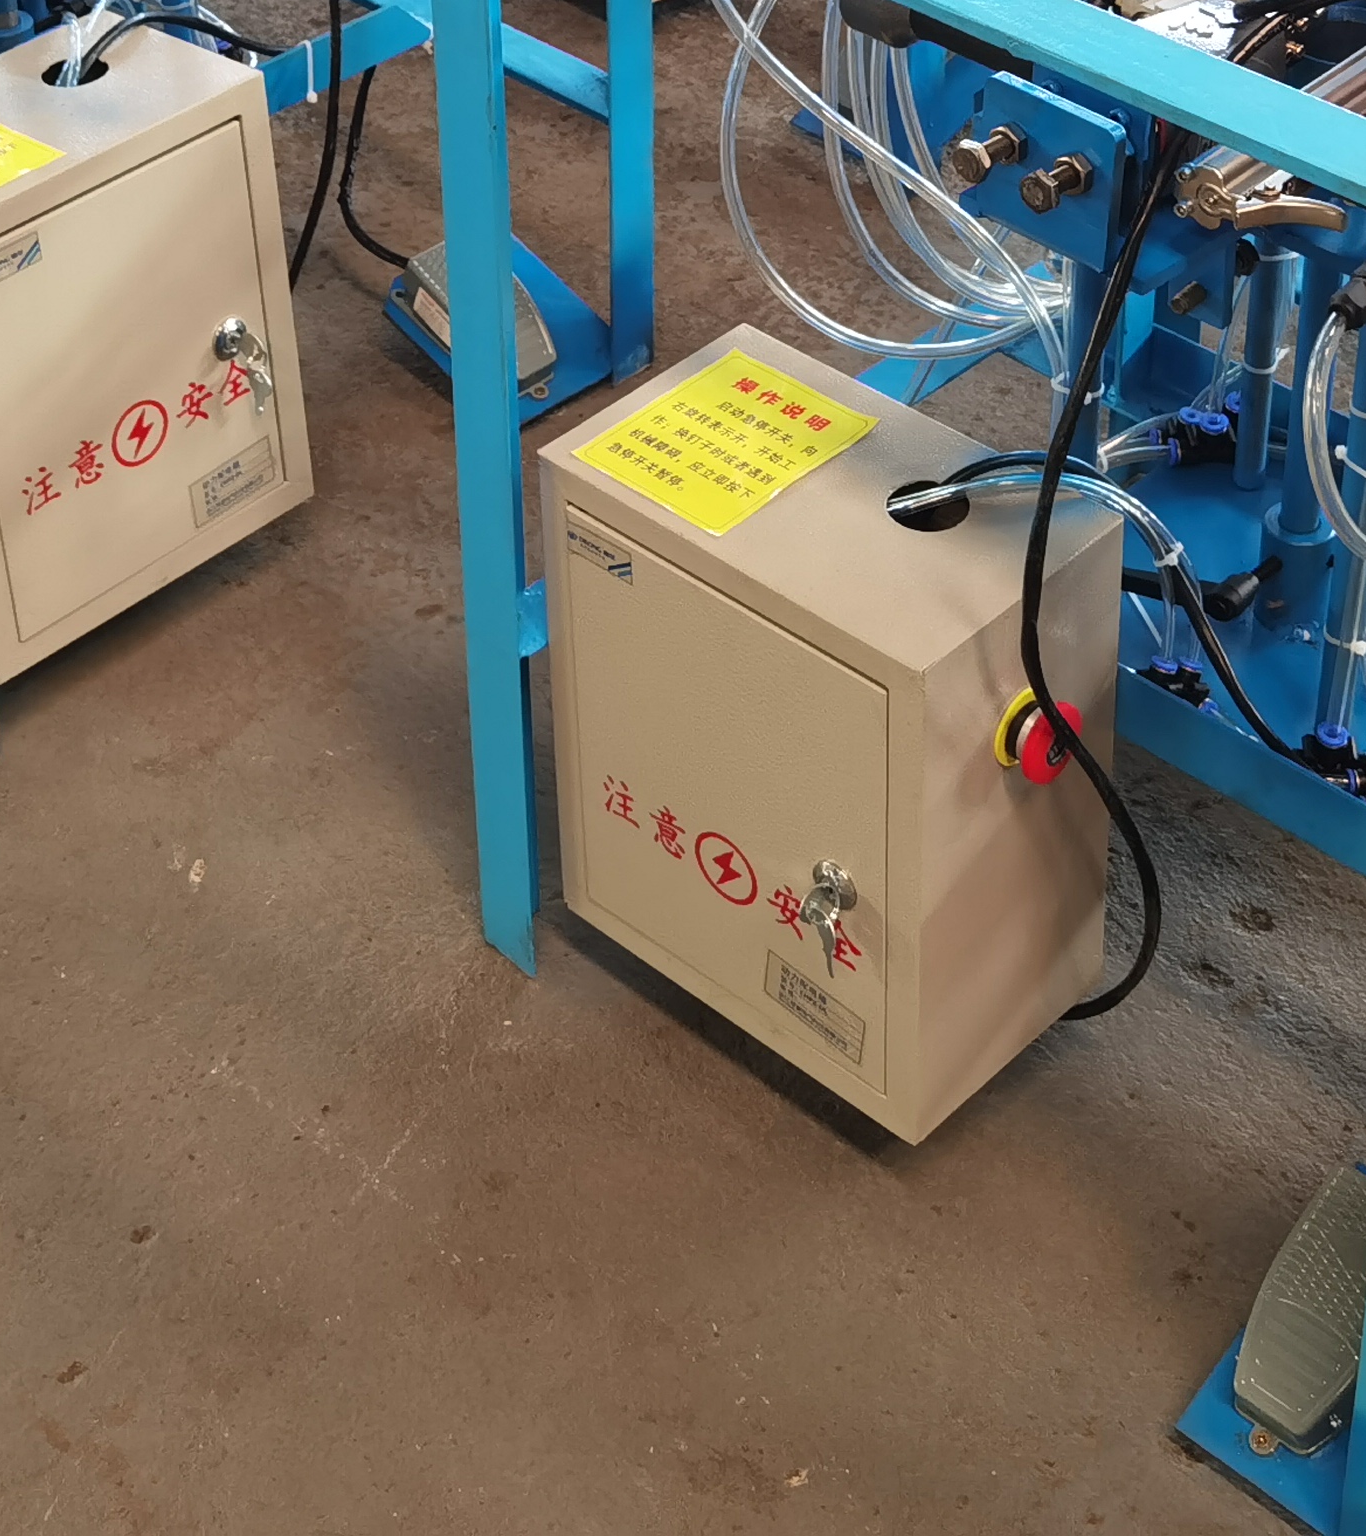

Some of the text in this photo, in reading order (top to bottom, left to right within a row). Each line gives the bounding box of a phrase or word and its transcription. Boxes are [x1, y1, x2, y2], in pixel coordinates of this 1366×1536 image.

[22, 359, 251, 516] 注意 安全
[731, 376, 833, 433] 操作说明
[602, 774, 686, 860] 注意
